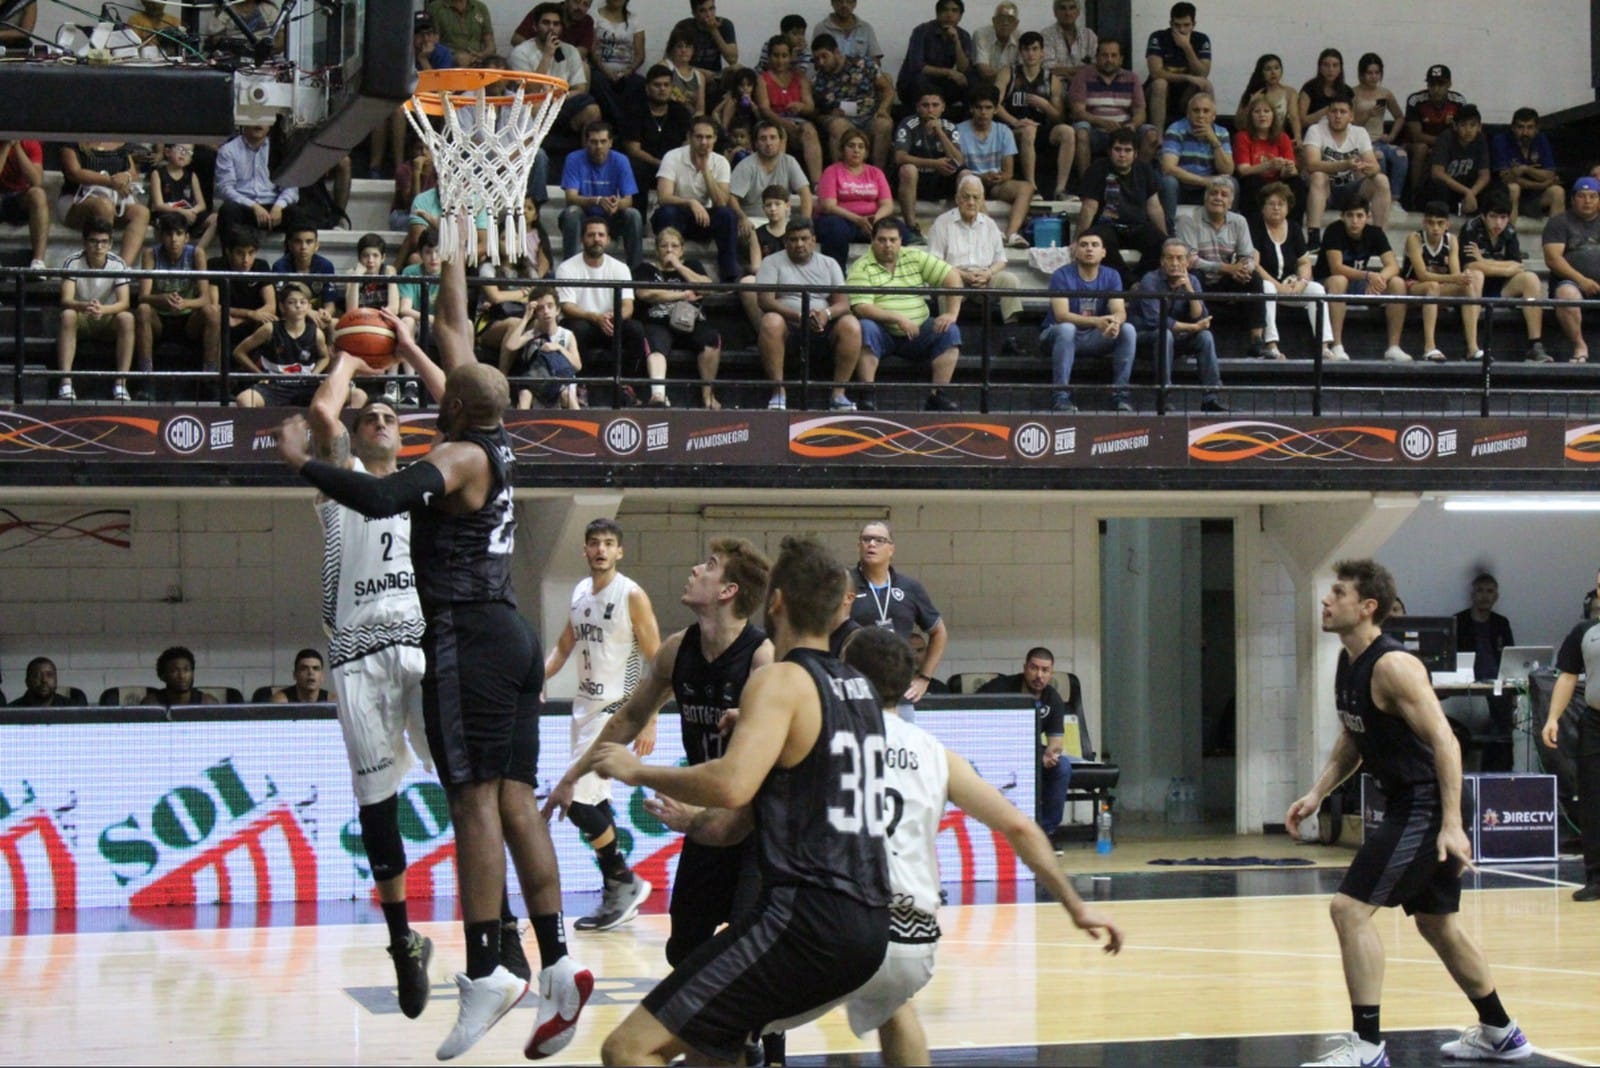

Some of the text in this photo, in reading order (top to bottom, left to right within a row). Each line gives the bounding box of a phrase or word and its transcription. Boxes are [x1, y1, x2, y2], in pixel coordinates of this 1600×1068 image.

[686, 428, 750, 452] #VAMOSNEGRO
[1090, 434, 1149, 456] #VAMOSNEGRO
[1471, 435, 1528, 457] #VAMOSNEGRO
[380, 531, 394, 562] 2
[828, 730, 886, 838] 36
[98, 756, 278, 887] SOL
[1501, 810, 1555, 824] DIRECTV
